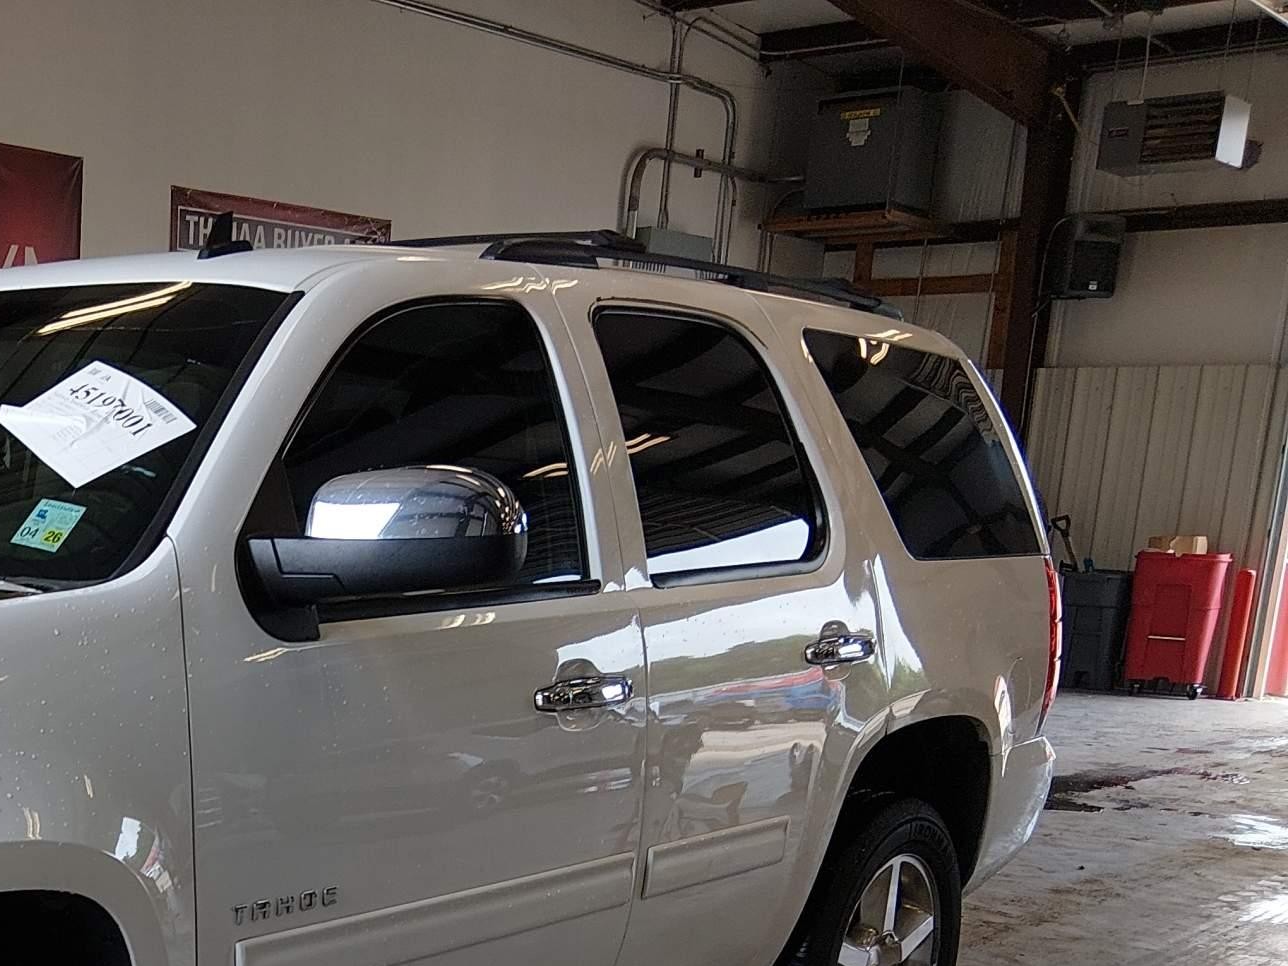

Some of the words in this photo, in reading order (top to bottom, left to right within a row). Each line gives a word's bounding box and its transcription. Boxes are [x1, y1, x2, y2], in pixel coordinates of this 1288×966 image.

[20, 526, 40, 539] 04
[44, 531, 62, 544] 26
[232, 886, 339, 926] TAHOE
